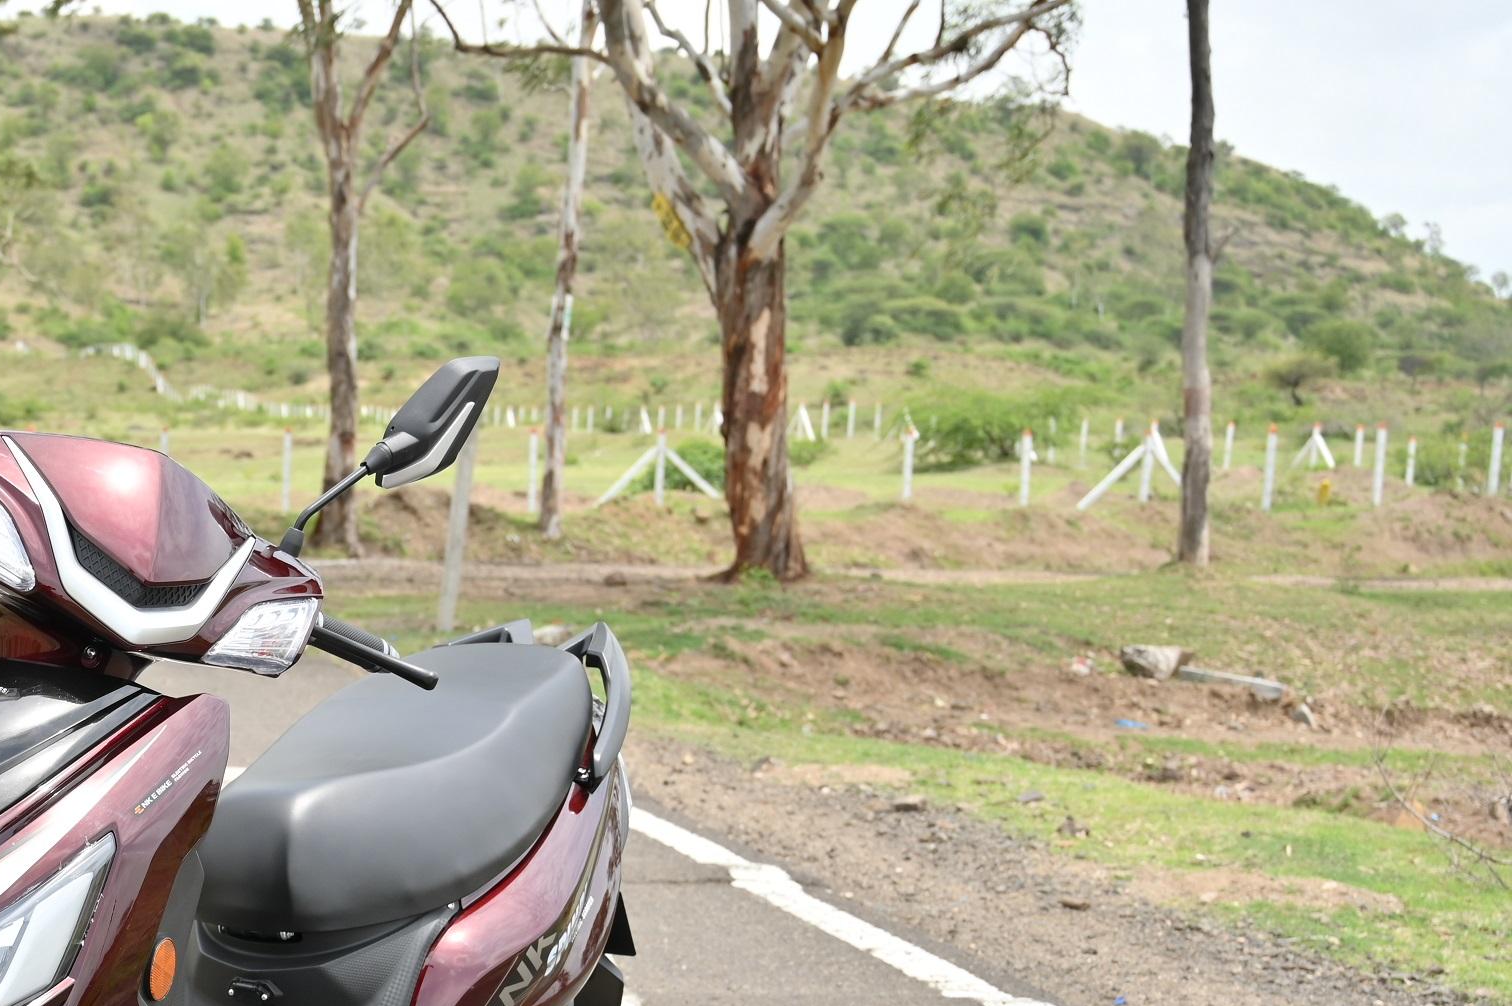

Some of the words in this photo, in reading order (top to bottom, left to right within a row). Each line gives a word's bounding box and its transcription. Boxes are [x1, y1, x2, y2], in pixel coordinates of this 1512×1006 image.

[140, 796, 154, 808] NK
[150, 791, 159, 800] E
[155, 779, 173, 796] BIKE
